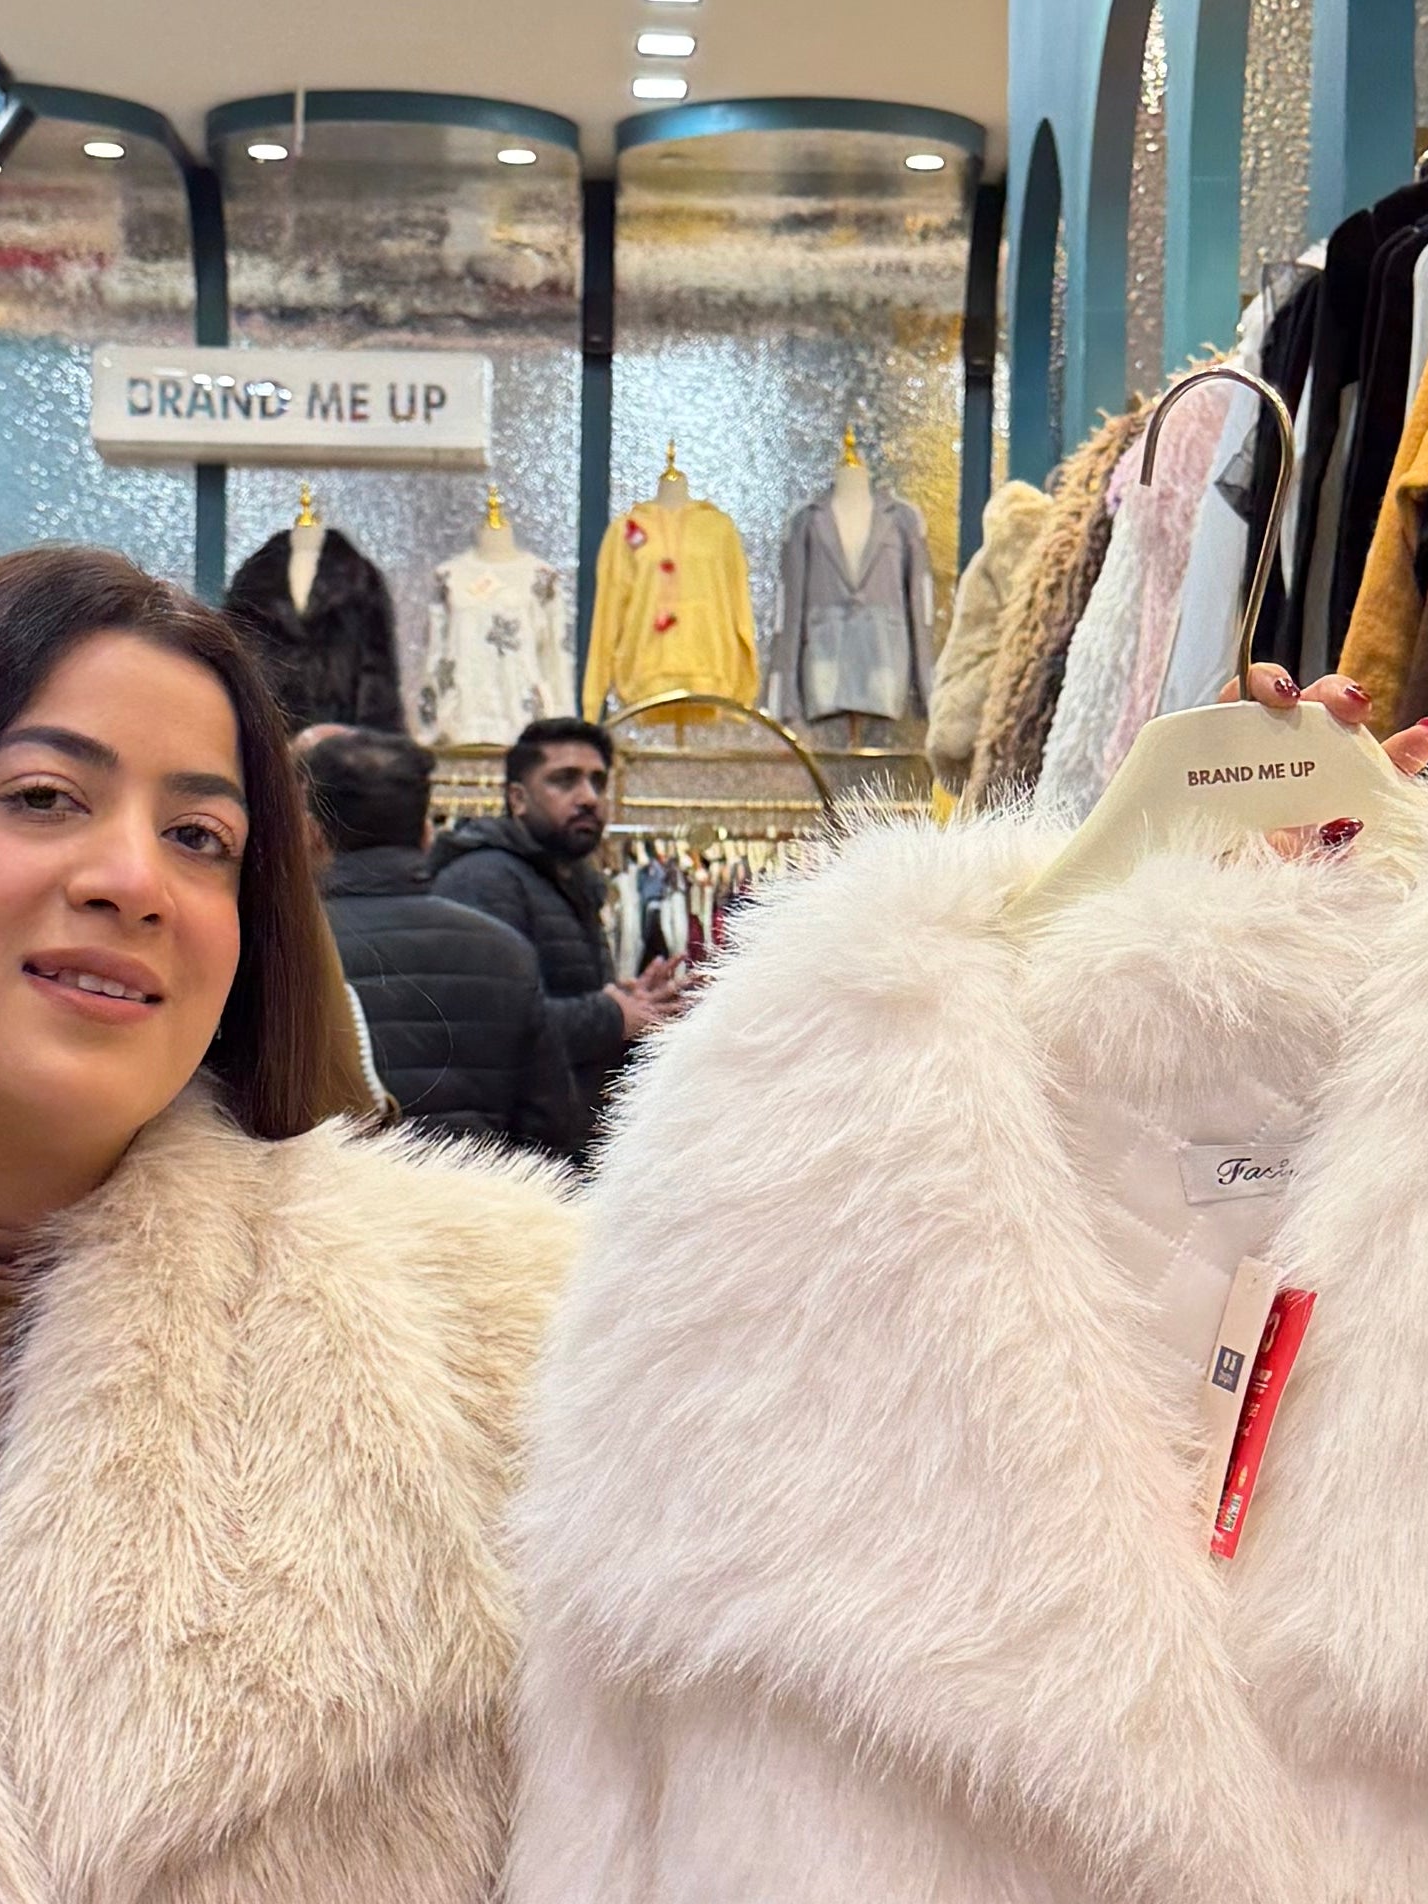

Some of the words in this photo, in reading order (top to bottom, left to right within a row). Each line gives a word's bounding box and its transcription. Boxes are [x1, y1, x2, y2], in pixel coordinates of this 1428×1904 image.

[127, 377, 293, 421] BRAND
[305, 380, 370, 423] ME
[388, 382, 448, 424] UP
[1187, 766, 1254, 786] BRAND
[1258, 763, 1286, 780] ME
[1290, 761, 1316, 778] UP
